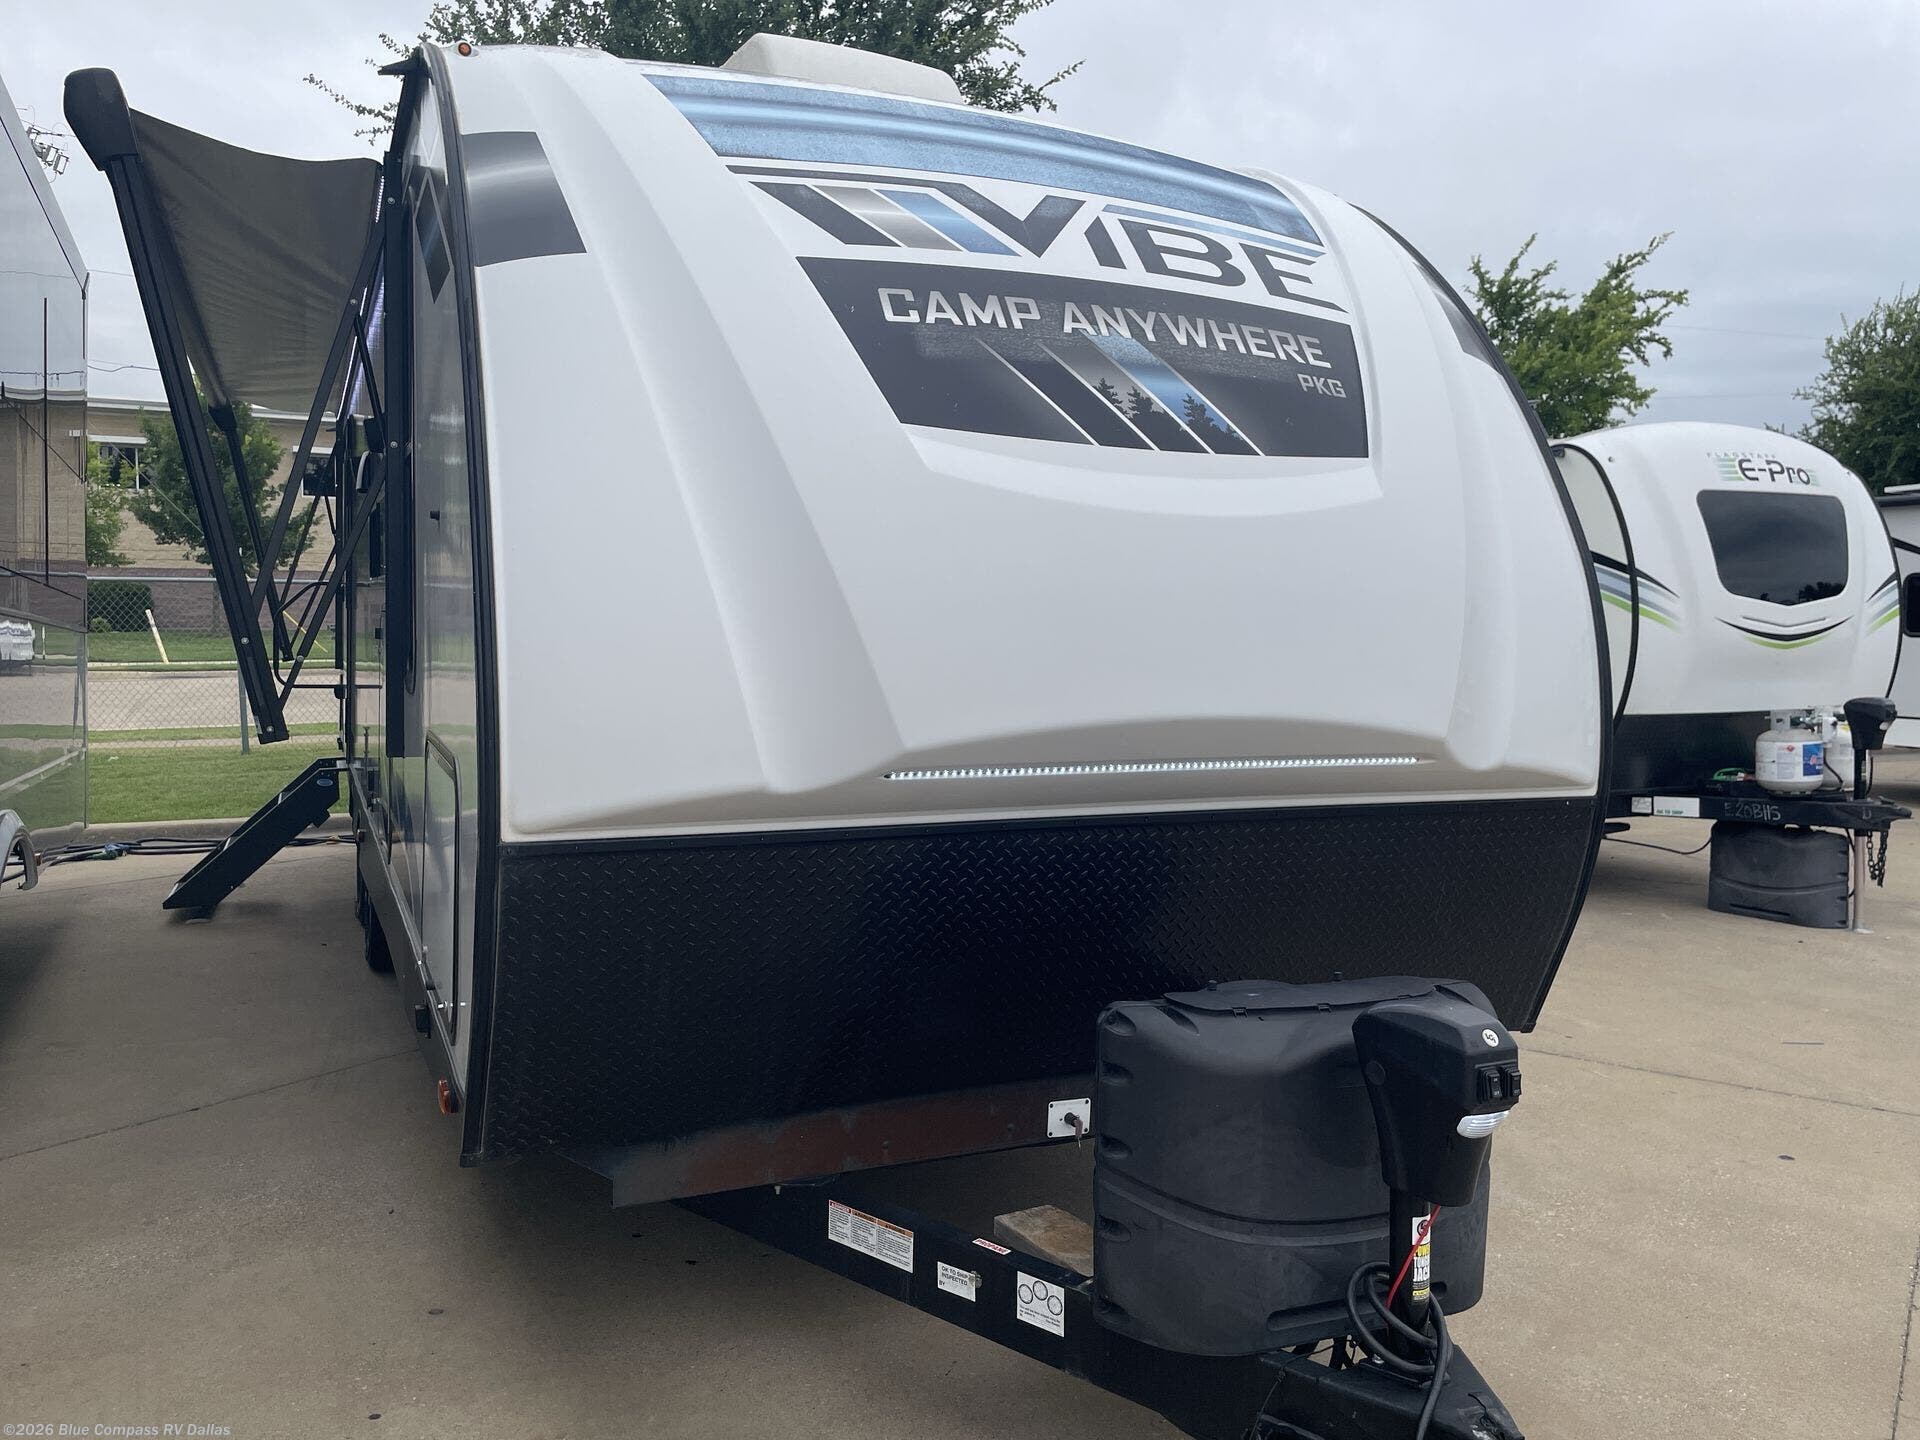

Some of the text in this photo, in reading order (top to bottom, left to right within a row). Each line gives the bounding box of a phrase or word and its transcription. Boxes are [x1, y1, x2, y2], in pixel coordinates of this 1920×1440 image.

[931, 184, 1350, 312] VIBE
[877, 287, 1332, 369] CAMP ANYWHERE
[1297, 373, 1347, 399] PKG
[1738, 458, 1811, 485] E-Pro
